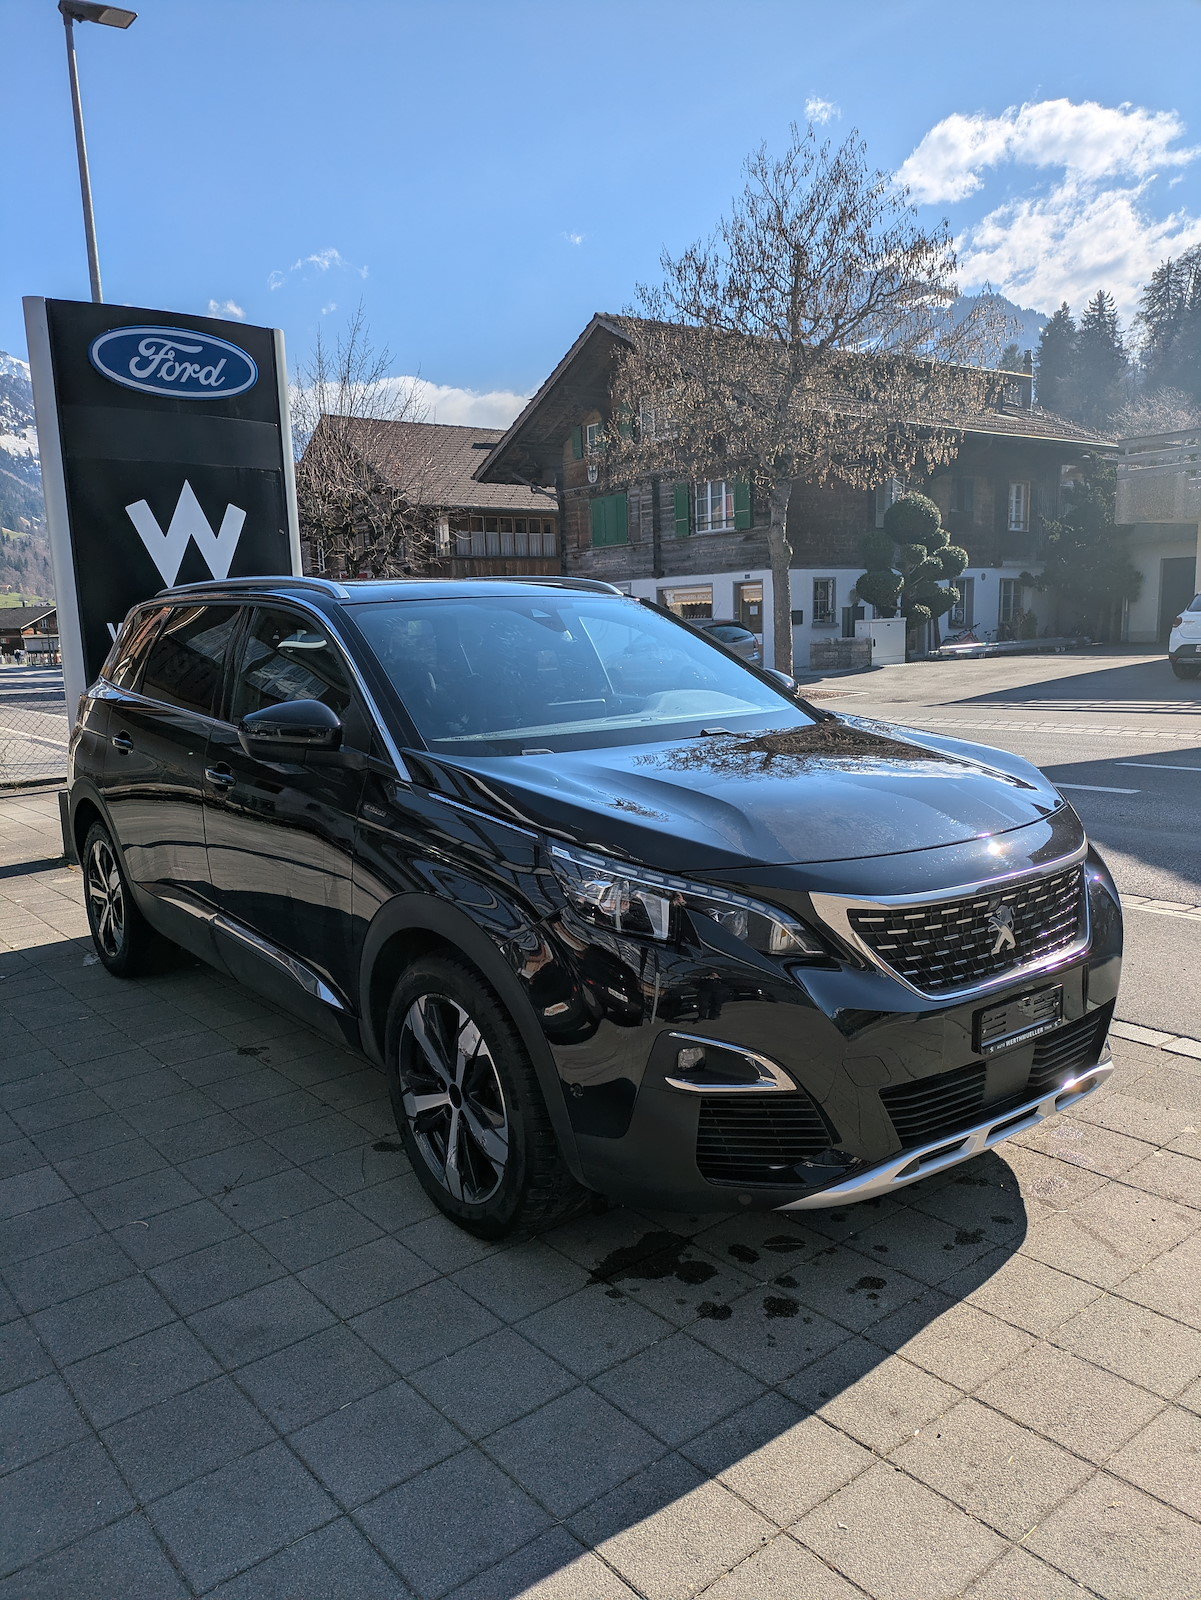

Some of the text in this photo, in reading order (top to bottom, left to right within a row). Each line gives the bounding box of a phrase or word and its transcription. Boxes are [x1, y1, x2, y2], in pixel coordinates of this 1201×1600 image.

[129, 337, 228, 387] Ford
[124, 479, 247, 589] W
[1005, 1027, 1044, 1046] WERTHMUELLER
